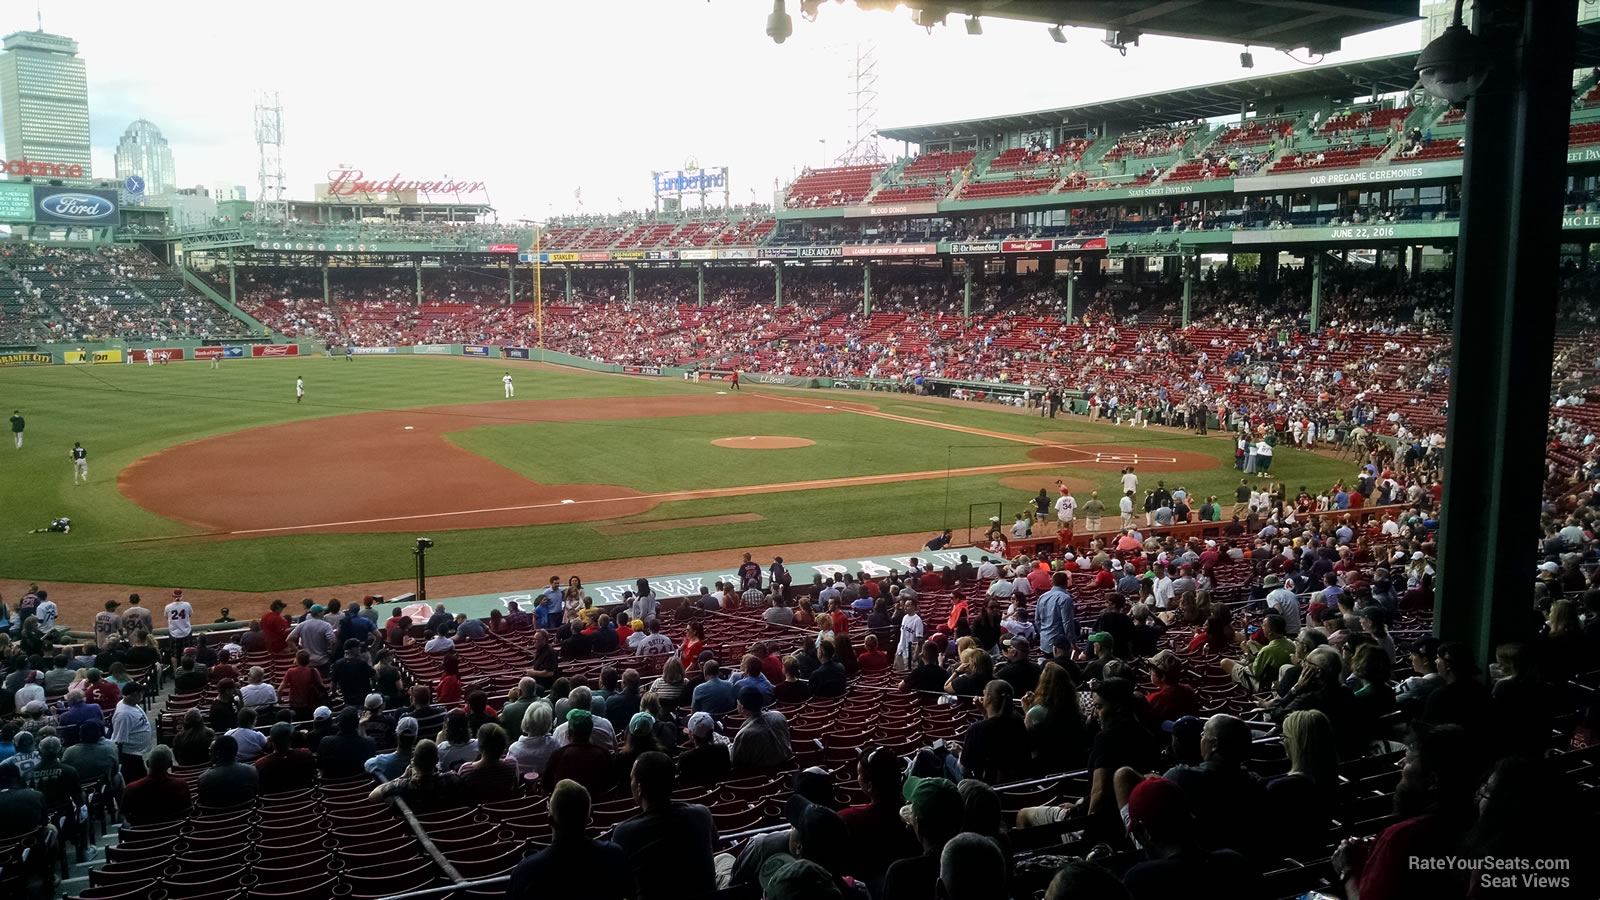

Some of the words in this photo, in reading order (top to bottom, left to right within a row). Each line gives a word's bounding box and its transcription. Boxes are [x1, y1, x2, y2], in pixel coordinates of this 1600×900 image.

[655, 170, 724, 191] Cumberland
[1310, 176, 1326, 184] OUR
[1328, 172, 1367, 183] PREGAME
[1369, 168, 1423, 180] CEREMONIES
[328, 169, 485, 196] Budweiser
[1129, 189, 1144, 197] STATE
[1145, 187, 1164, 195] STREET
[1165, 186, 1192, 194] PAVILION
[56, 196, 100, 215] Ford
[871, 207, 888, 215] BLOOD
[889, 206, 907, 214] DONOR
[1331, 229, 1353, 238] JUNE
[1356, 229, 1370, 238] 22,
[1373, 227, 1394, 237] 2016
[801, 248, 815, 256] ALEX
[816, 248, 830, 256] AND
[0, 354, 32, 363] RANITE
[33, 354, 51, 362] CITY
[171, 609, 186, 620] 24
[126, 619, 143, 631] 34
[1570, 738, 1587, 750] 150
